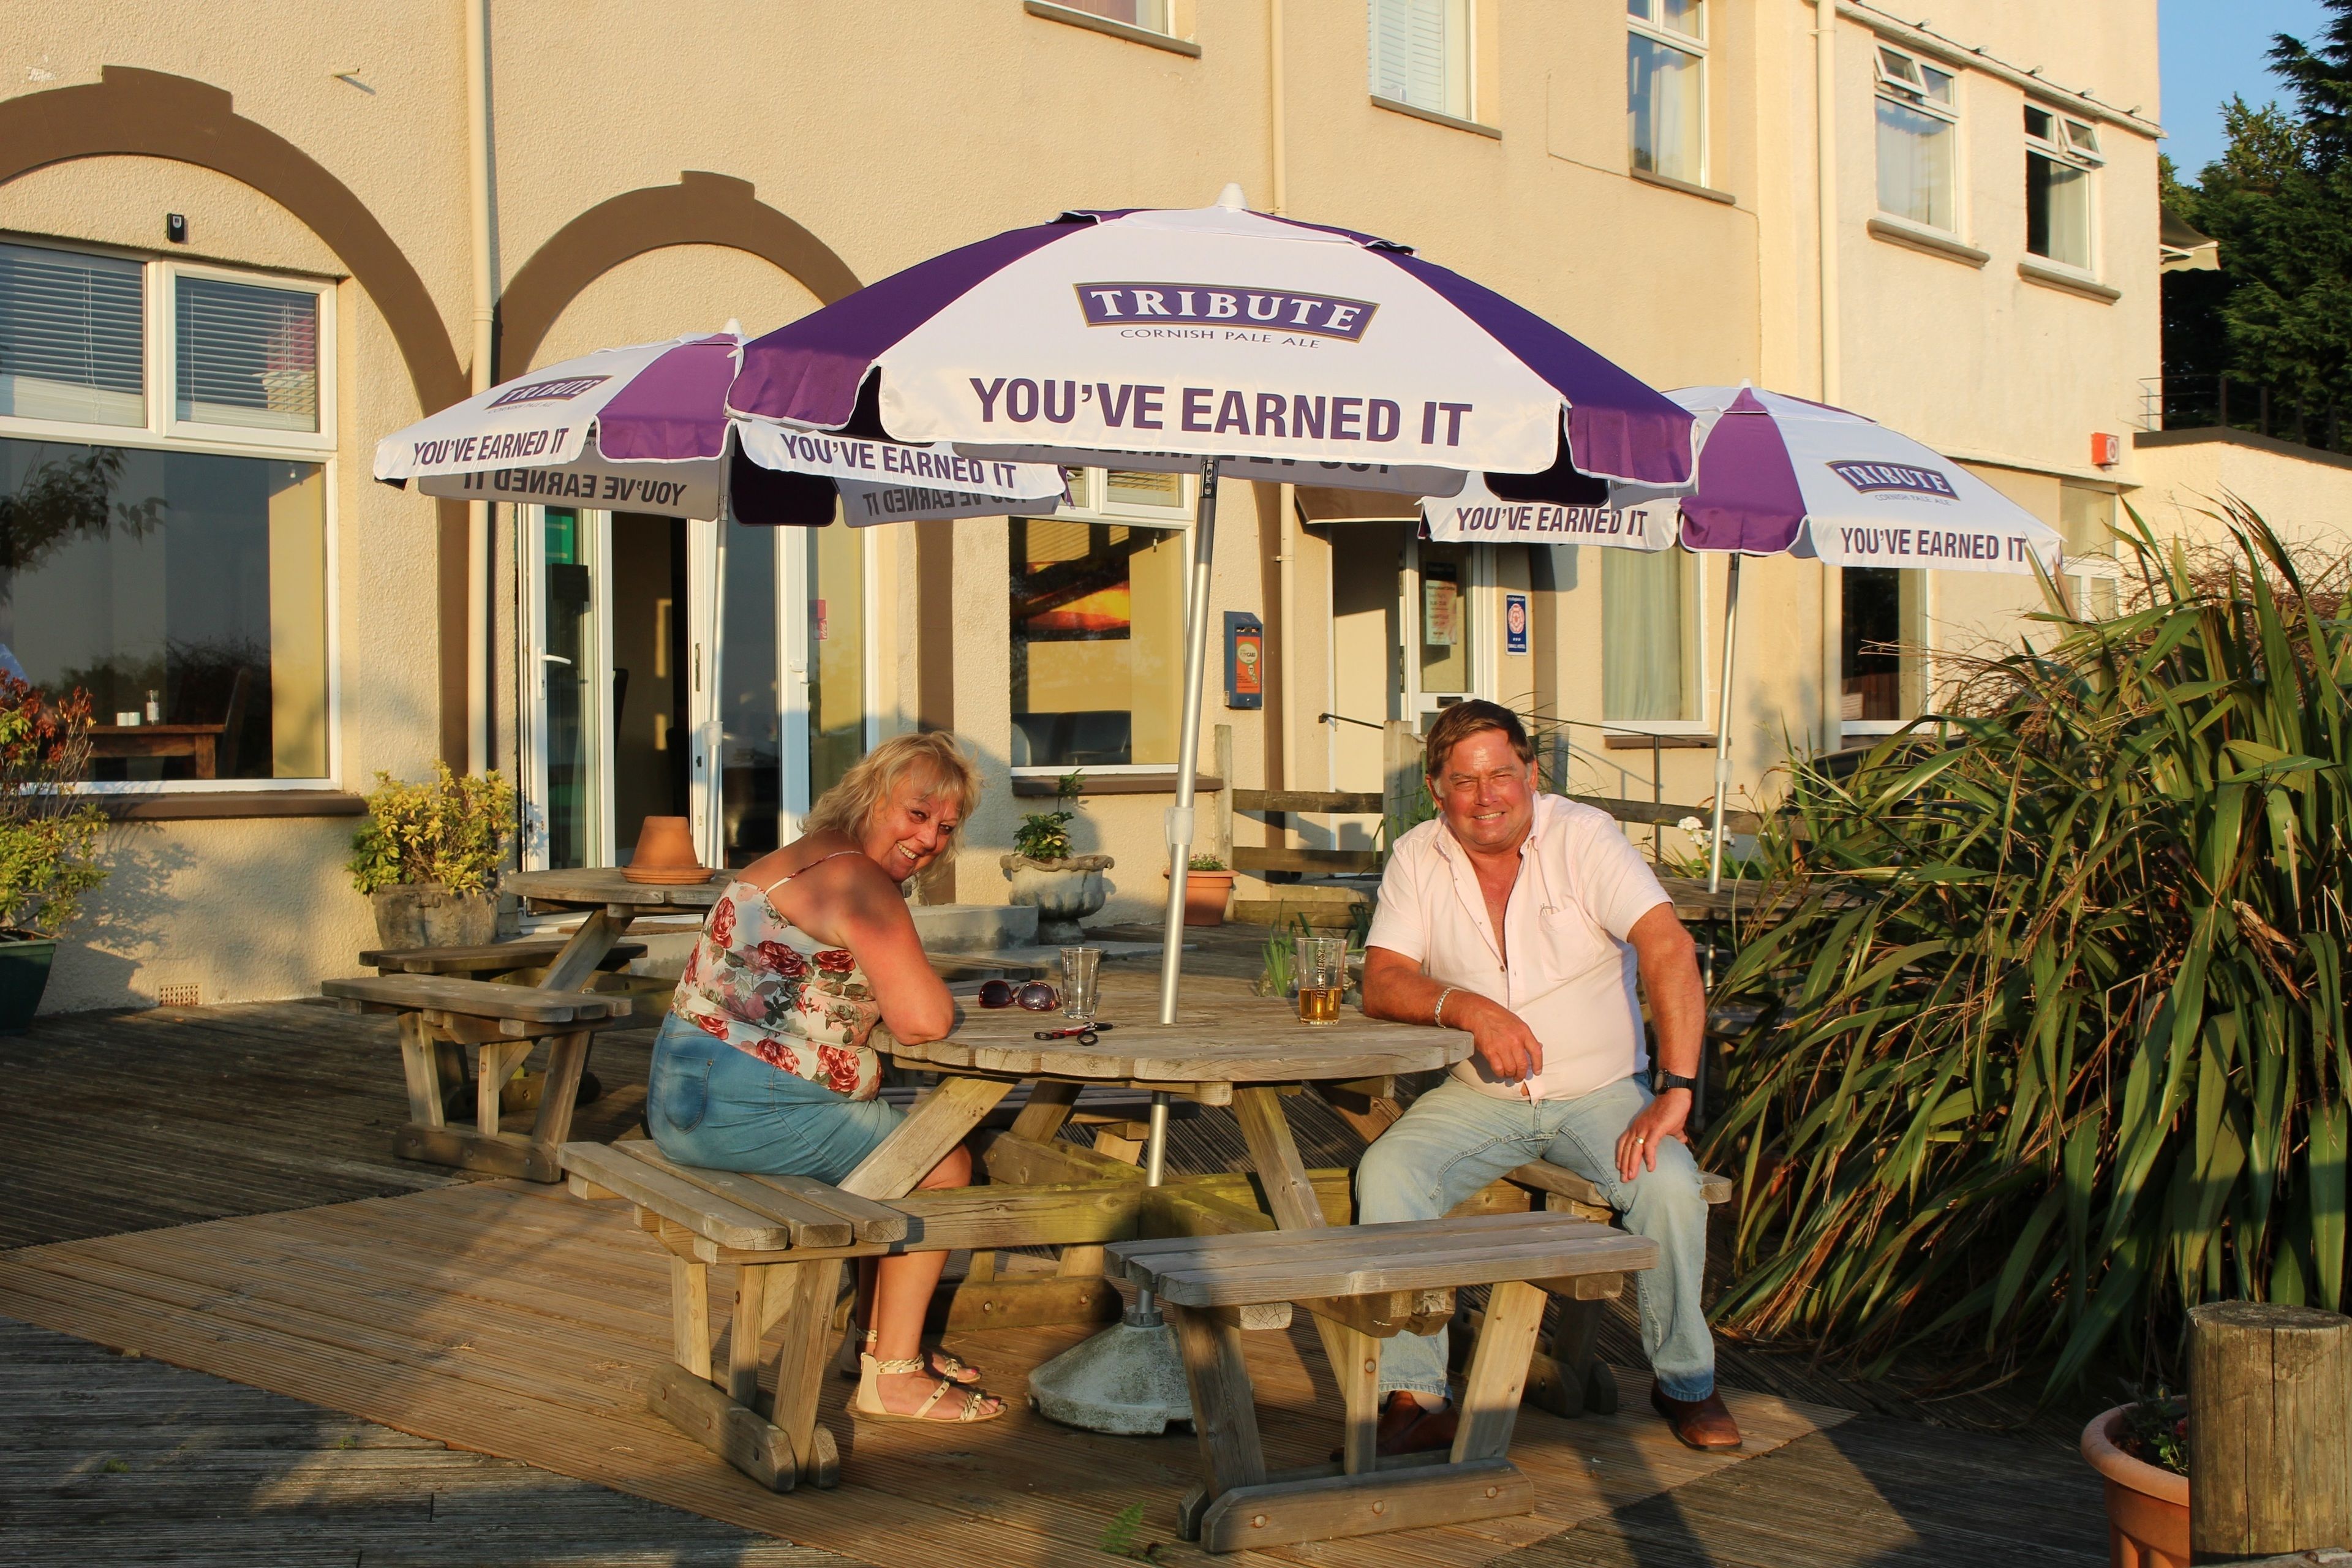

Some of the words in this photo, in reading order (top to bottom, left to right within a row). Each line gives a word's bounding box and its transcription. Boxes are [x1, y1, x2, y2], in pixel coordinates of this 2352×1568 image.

[1090, 289, 1362, 331] TRIBUTE
[1120, 329, 1214, 340] CORNISH
[1225, 331, 1272, 344] PALE
[1281, 337, 1321, 349] ALE
[499, 380, 601, 404] TRIBUTE
[969, 377, 1167, 430] YOU'VE
[1182, 388, 1400, 442] EARNED
[1421, 401, 1472, 447] IT
[413, 437, 478, 466] YOU'VE
[477, 430, 549, 460] EARNED
[550, 428, 569, 454] IT
[780, 433, 876, 470] YOU'VE
[883, 445, 984, 484] EARNED
[993, 462, 1016, 489] IT
[1836, 465, 1950, 492] TRIBUTE
[1457, 507, 1532, 531] YOU'VE
[1537, 507, 1622, 534] EARNED
[1626, 510, 1648, 537] IT
[1841, 527, 1911, 555] YOU'VE
[1917, 530, 1999, 560] EARNED
[2007, 537, 2026, 562] IT
